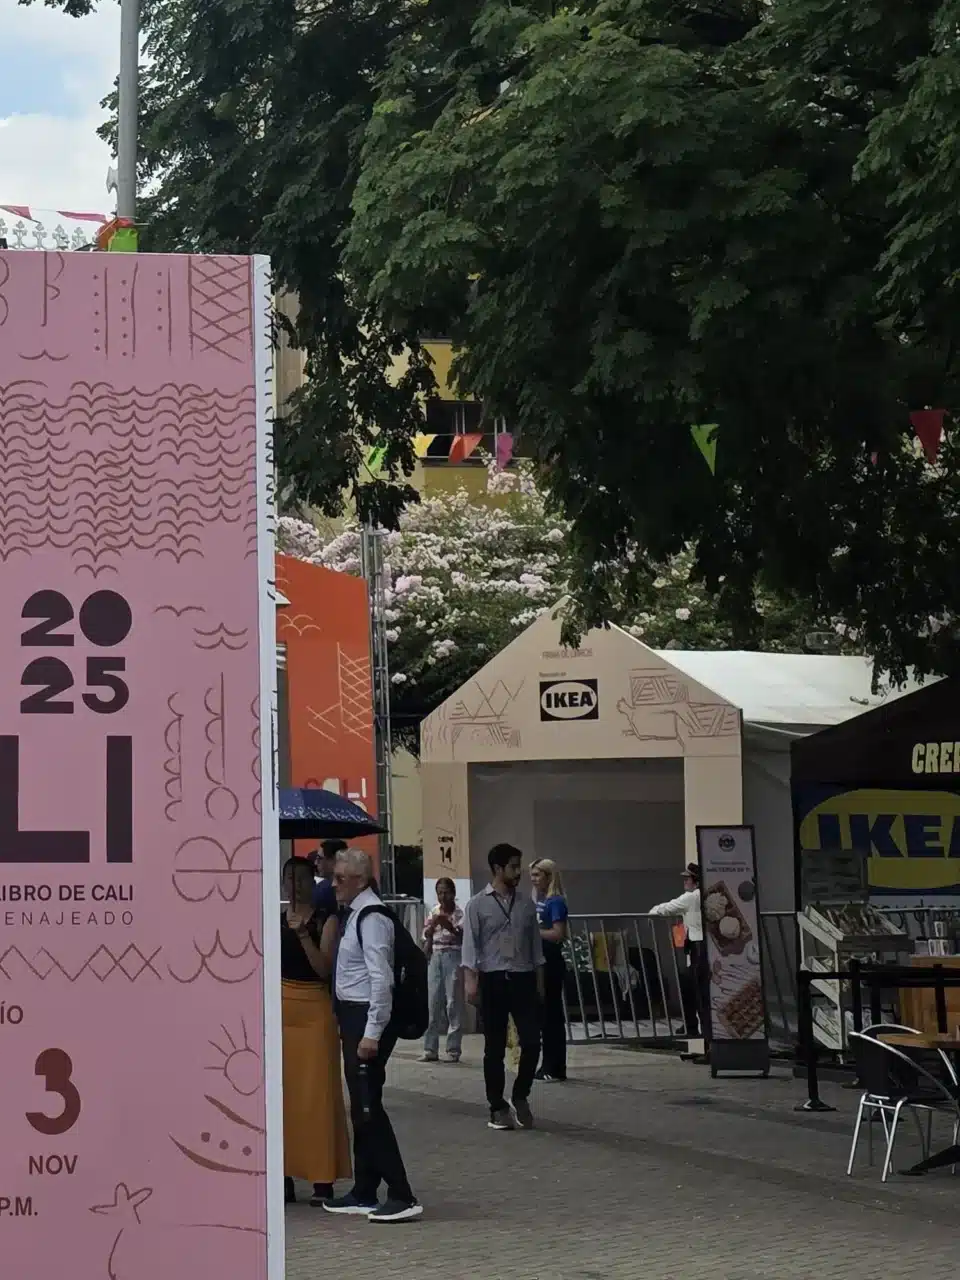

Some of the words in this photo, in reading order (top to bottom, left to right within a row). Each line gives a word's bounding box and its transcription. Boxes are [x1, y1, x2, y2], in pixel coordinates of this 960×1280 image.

[21, 590, 132, 646] 20
[20, 656, 129, 714] 25
[546, 691, 593, 708] IKEA
[818, 814, 960, 858] IKE
[440, 847, 452, 863] 14
[59, 885, 85, 901] DE
[92, 885, 132, 901] CALI
[26, 1048, 80, 1135] 3
[29, 1155, 77, 1174] NOV
